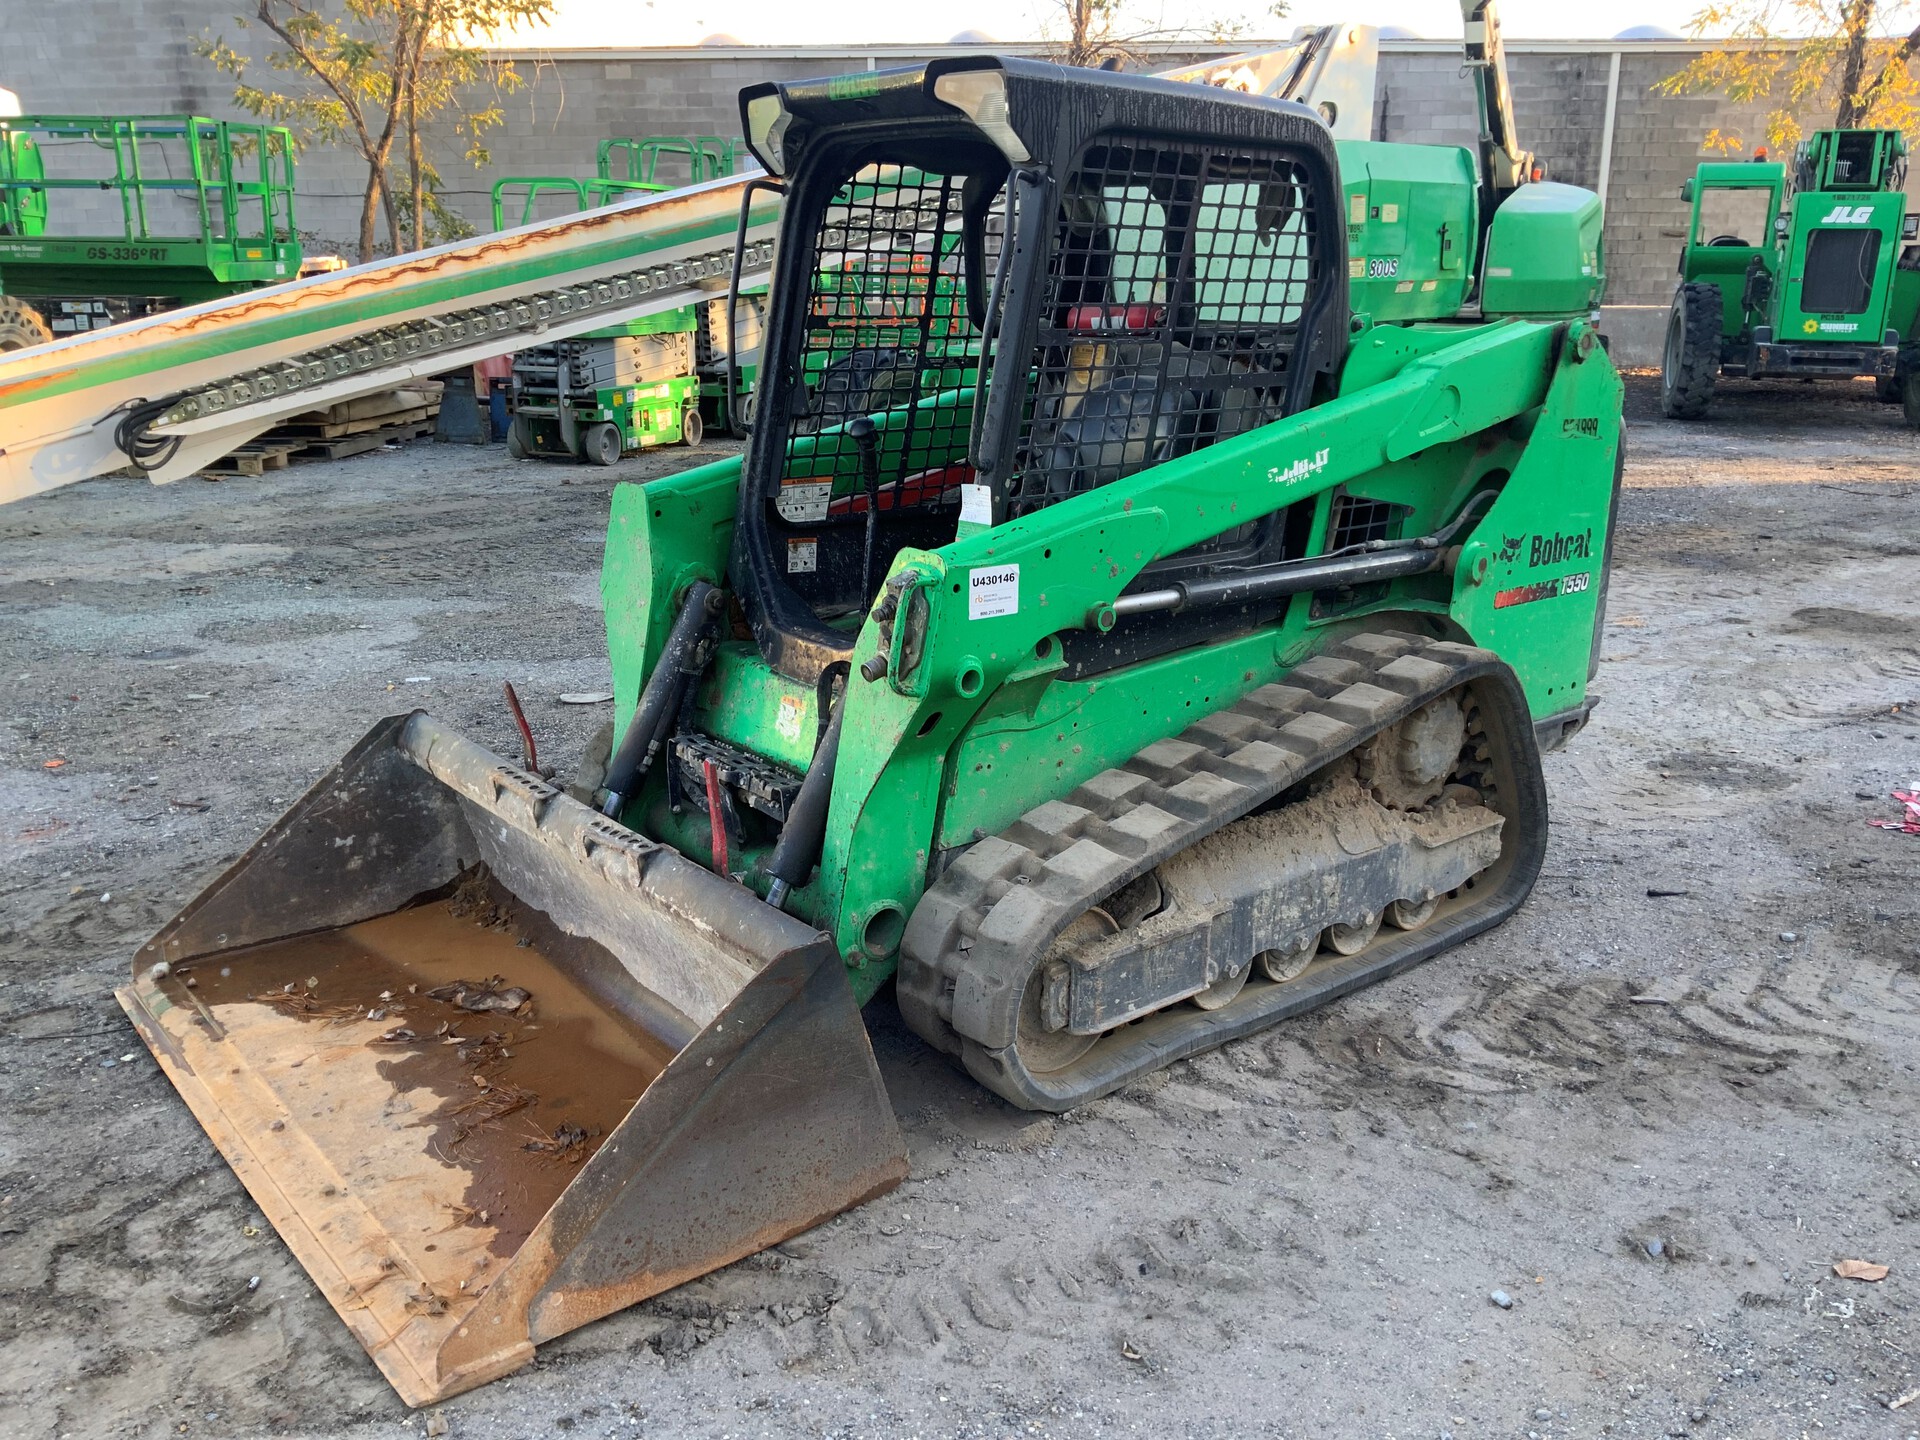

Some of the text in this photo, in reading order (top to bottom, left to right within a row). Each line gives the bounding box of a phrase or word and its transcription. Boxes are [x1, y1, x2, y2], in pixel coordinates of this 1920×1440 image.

[1821, 206, 1875, 223] JLG
[1368, 258, 1399, 278] 800S
[1529, 527, 1592, 568] Bobcat
[972, 573, 1015, 587] U430146
[1560, 571, 1590, 596] T550
